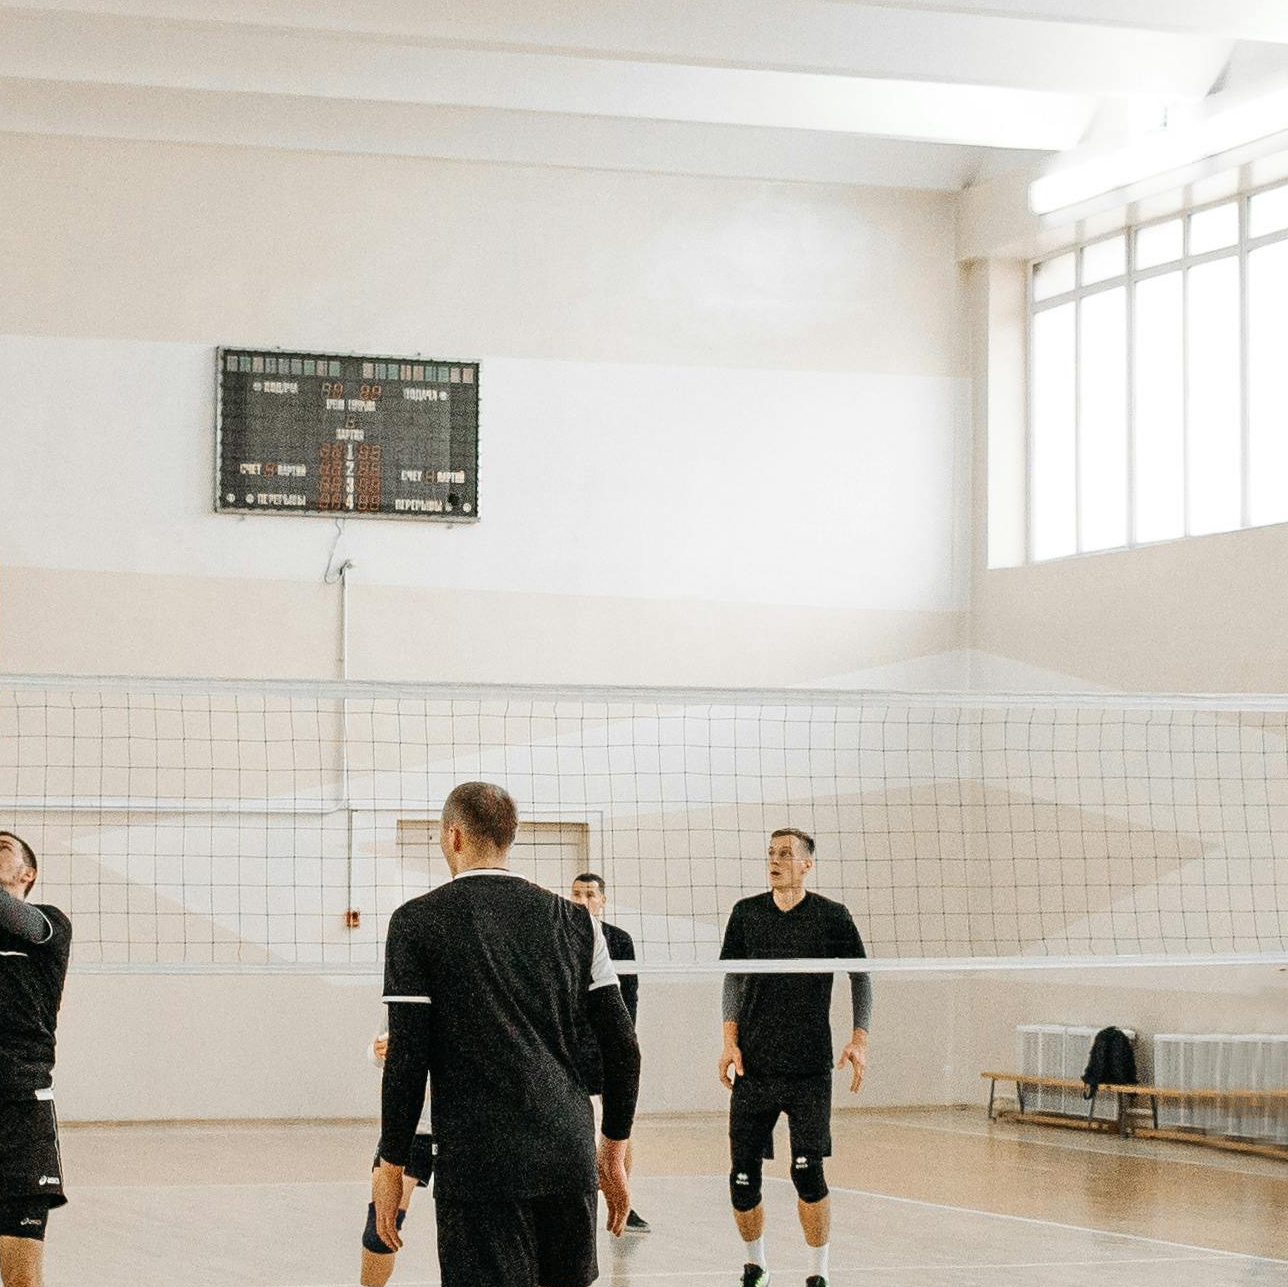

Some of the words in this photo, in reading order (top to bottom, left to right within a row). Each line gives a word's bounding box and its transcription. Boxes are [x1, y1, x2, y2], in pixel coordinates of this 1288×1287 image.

[346, 443, 355, 460] 1
[345, 460, 355, 476] 2
[345, 477, 355, 493] 3
[345, 493, 355, 510] 4
